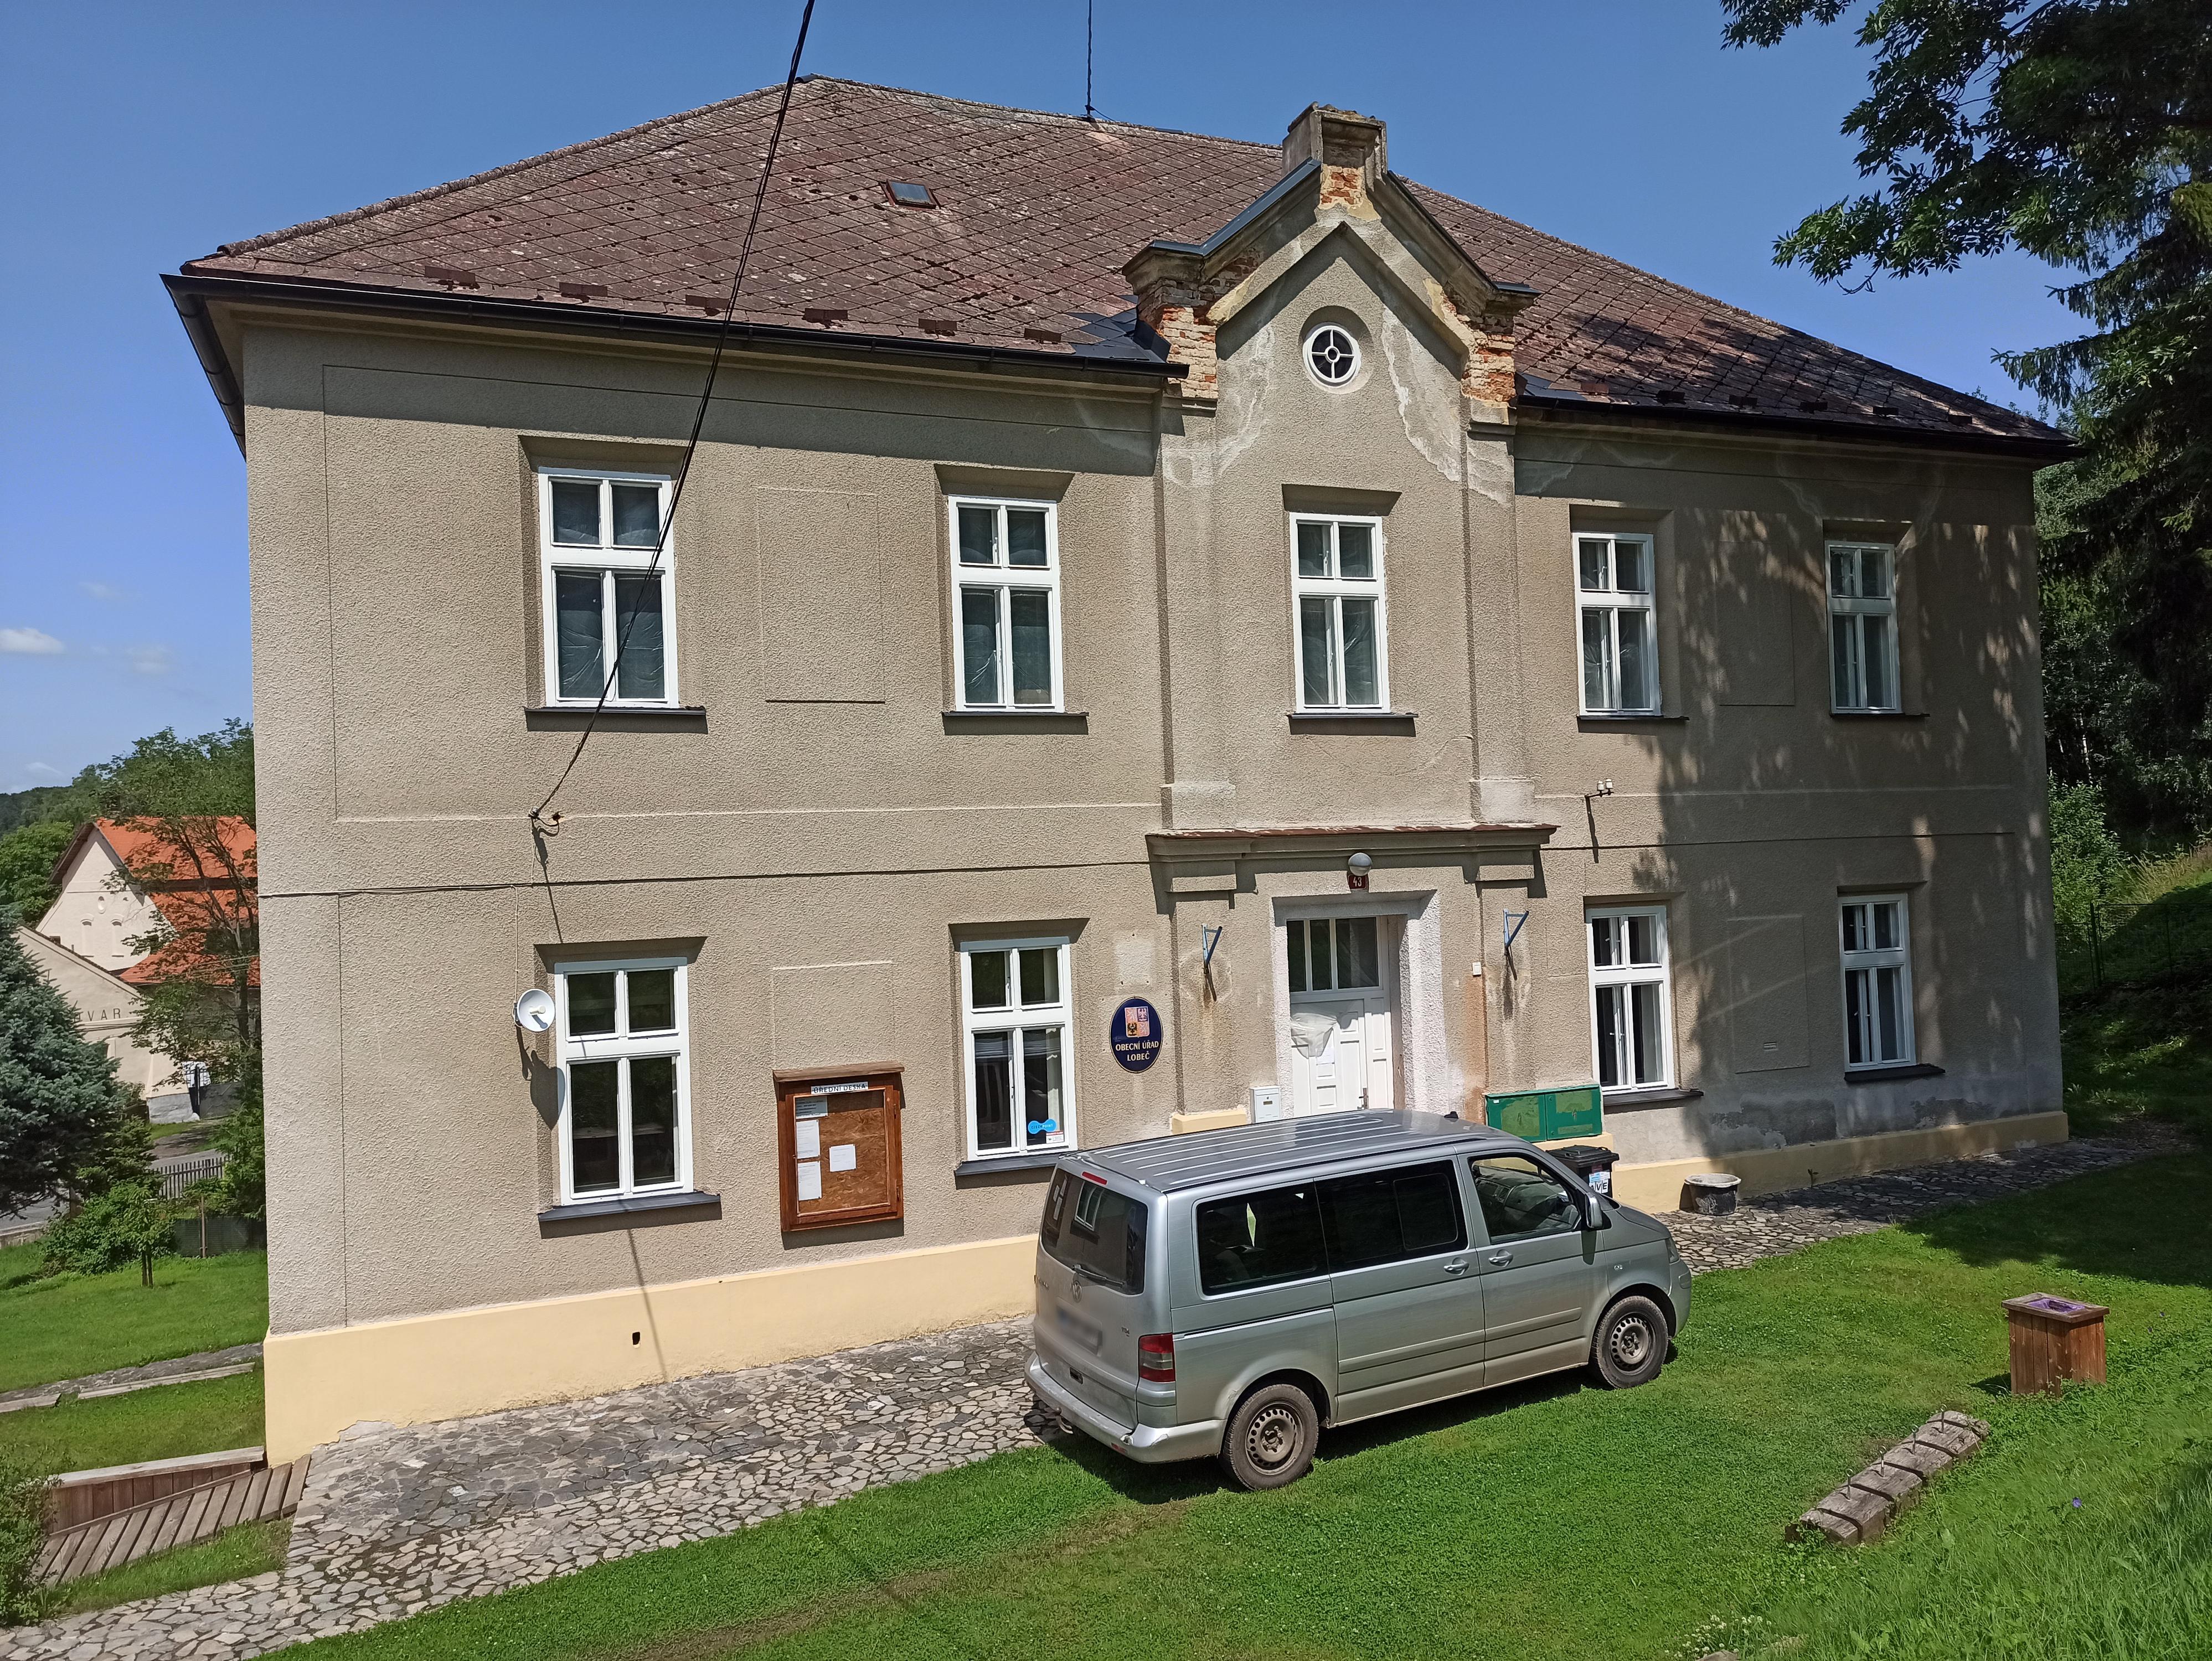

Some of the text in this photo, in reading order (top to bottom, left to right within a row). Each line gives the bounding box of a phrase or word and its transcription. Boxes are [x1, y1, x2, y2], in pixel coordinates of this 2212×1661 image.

[1353, 876, 1362, 887] 43
[1115, 1040, 1159, 1051] OBECNÍ ÚŘAD
[1127, 1051, 1150, 1061] LOBEČ
